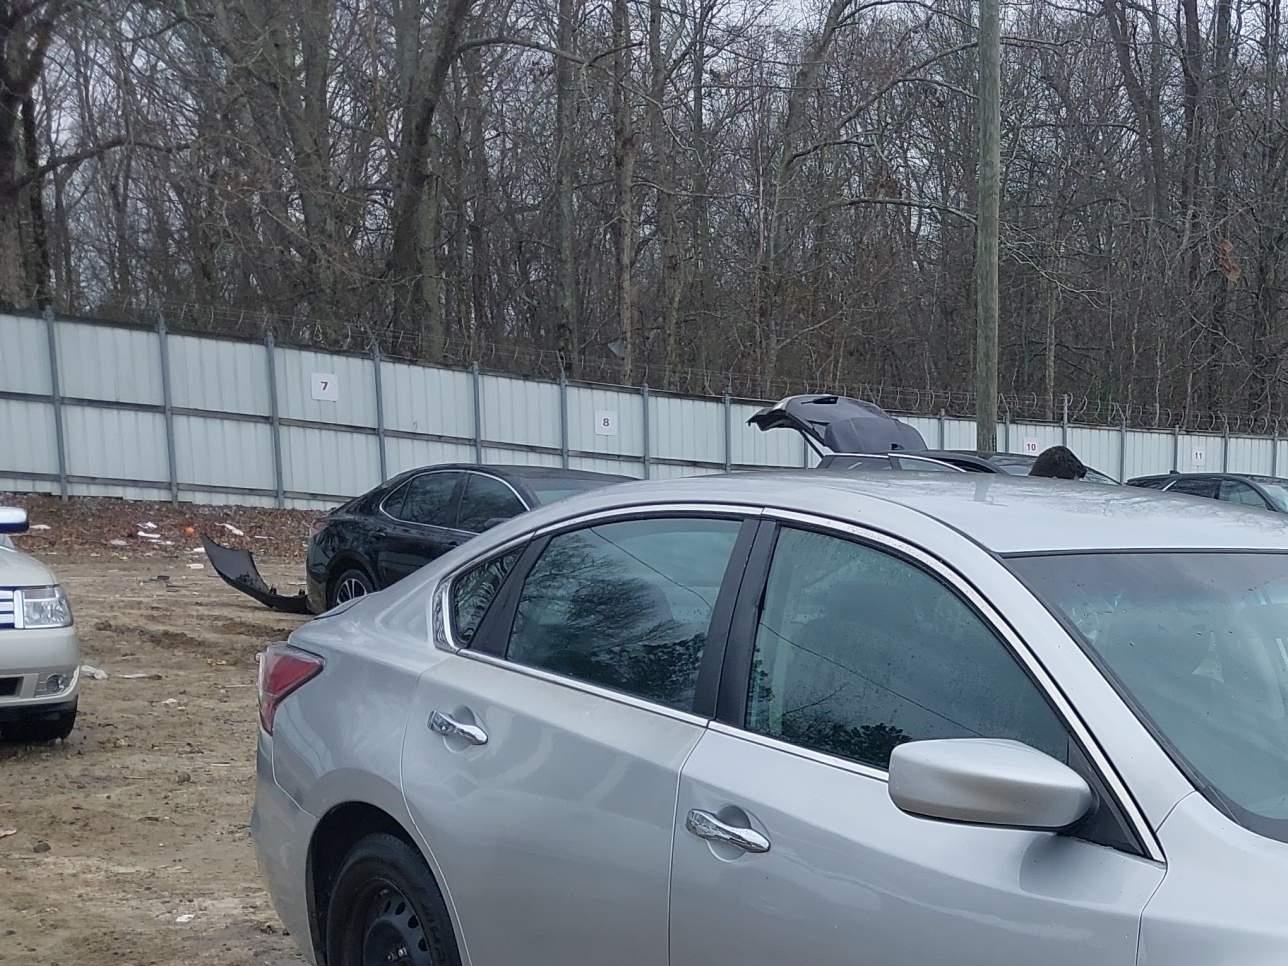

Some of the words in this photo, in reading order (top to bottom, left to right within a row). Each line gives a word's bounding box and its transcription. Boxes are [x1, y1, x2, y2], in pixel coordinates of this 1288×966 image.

[320, 381, 329, 391] 7
[602, 417, 611, 427] 8
[1026, 443, 1037, 452] 10
[1194, 452, 1203, 460] 11
